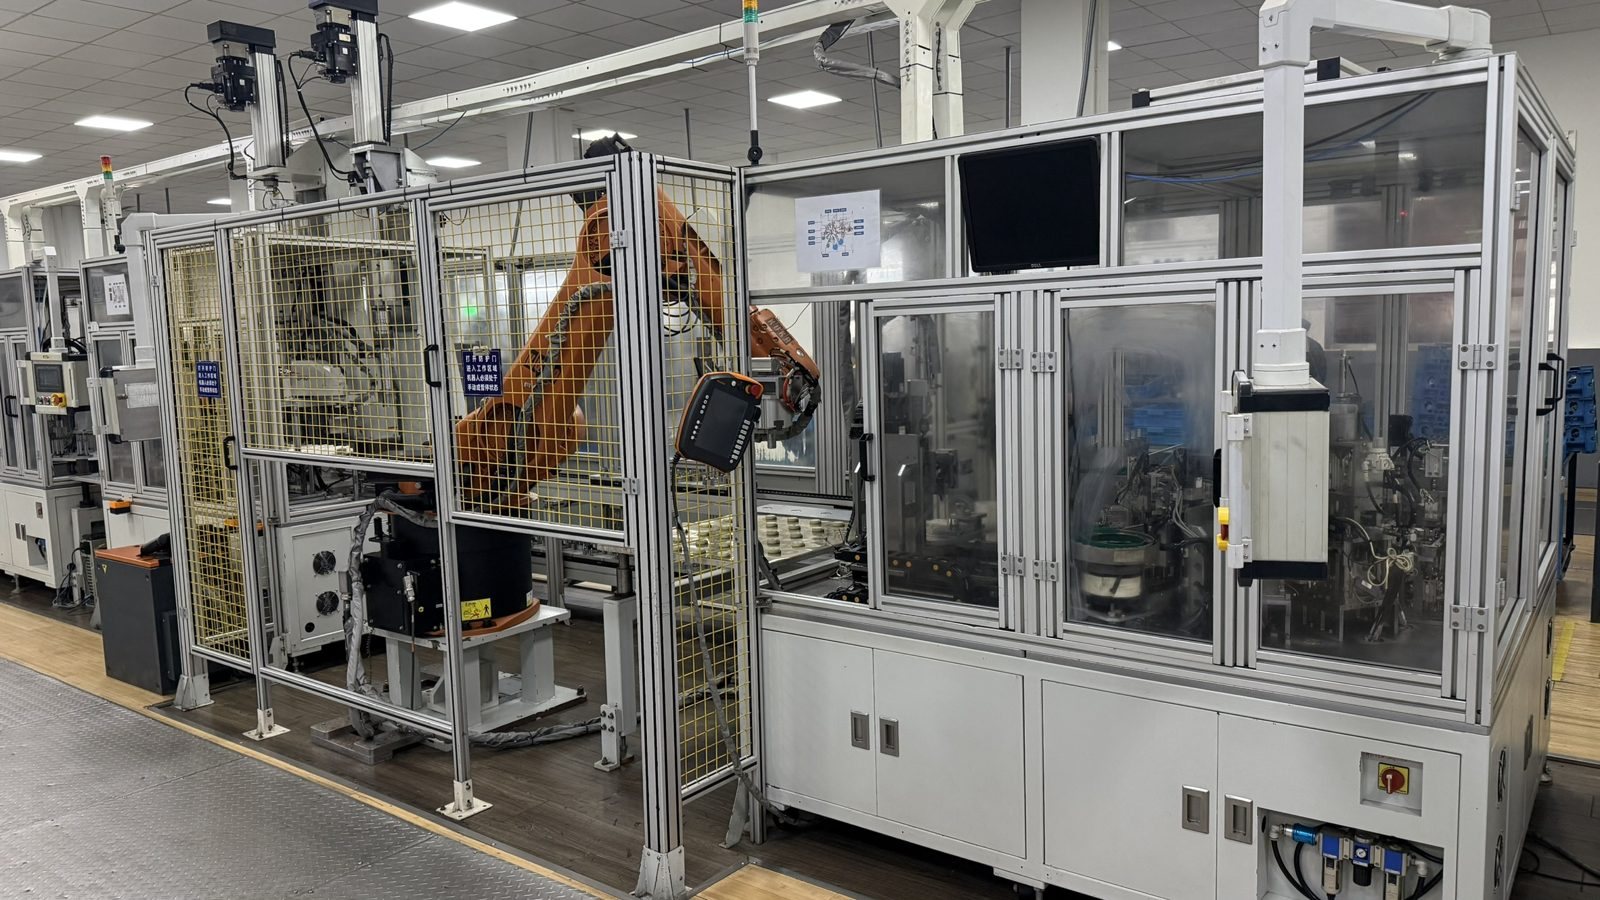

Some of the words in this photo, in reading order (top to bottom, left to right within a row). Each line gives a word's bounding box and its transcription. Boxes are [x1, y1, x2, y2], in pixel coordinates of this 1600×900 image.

[767, 318, 792, 344] KUKA
[466, 364, 498, 372] 进入工作区域
[466, 374, 498, 382] 机器人必须处于
